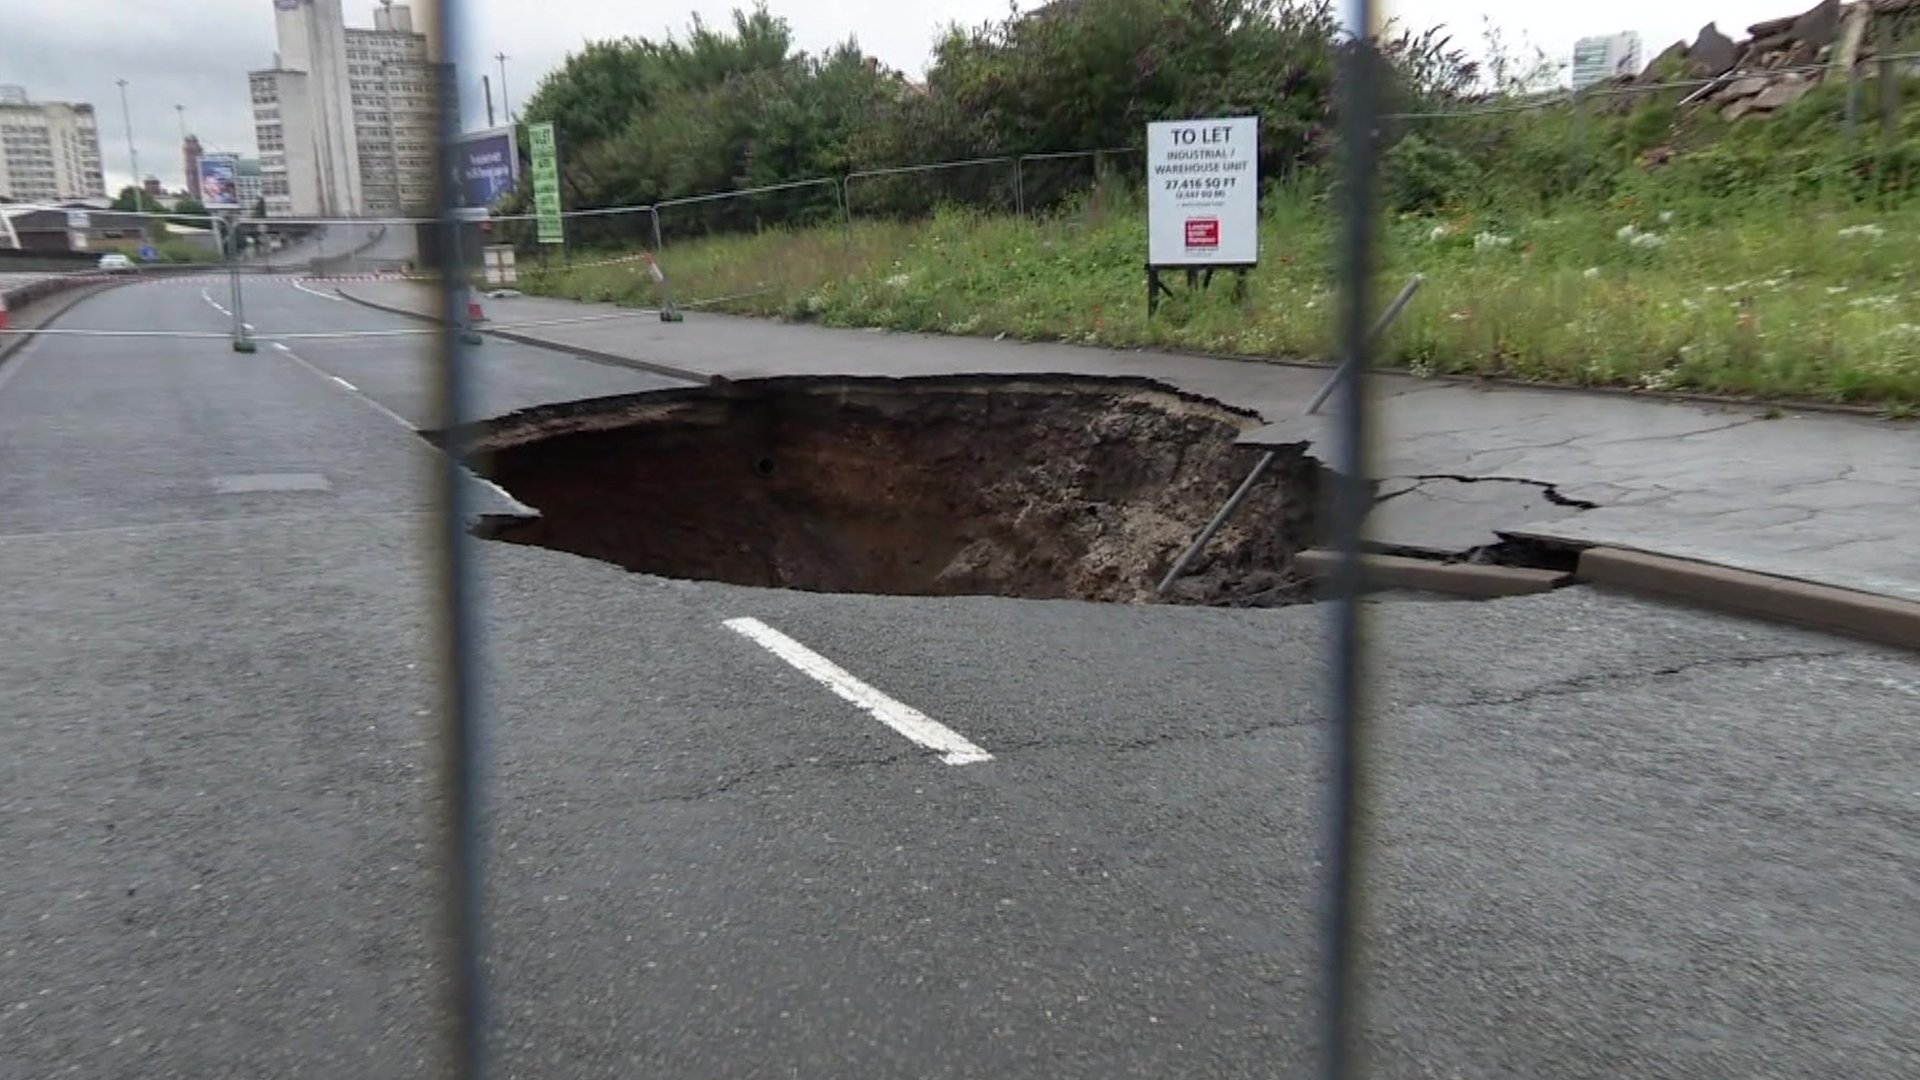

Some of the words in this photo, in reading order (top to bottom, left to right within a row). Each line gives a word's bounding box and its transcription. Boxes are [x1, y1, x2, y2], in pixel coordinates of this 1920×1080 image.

[1171, 128, 1196, 145] TO
[1203, 126, 1233, 144] LET
[1167, 149, 1227, 160] INDUSTRIAL
[1155, 162, 1220, 175] WAREHOUSE
[1223, 160, 1248, 171] UNIT
[1165, 178, 1202, 190] 27,416
[1205, 177, 1221, 189] SQ
[1223, 177, 1236, 187] FT
